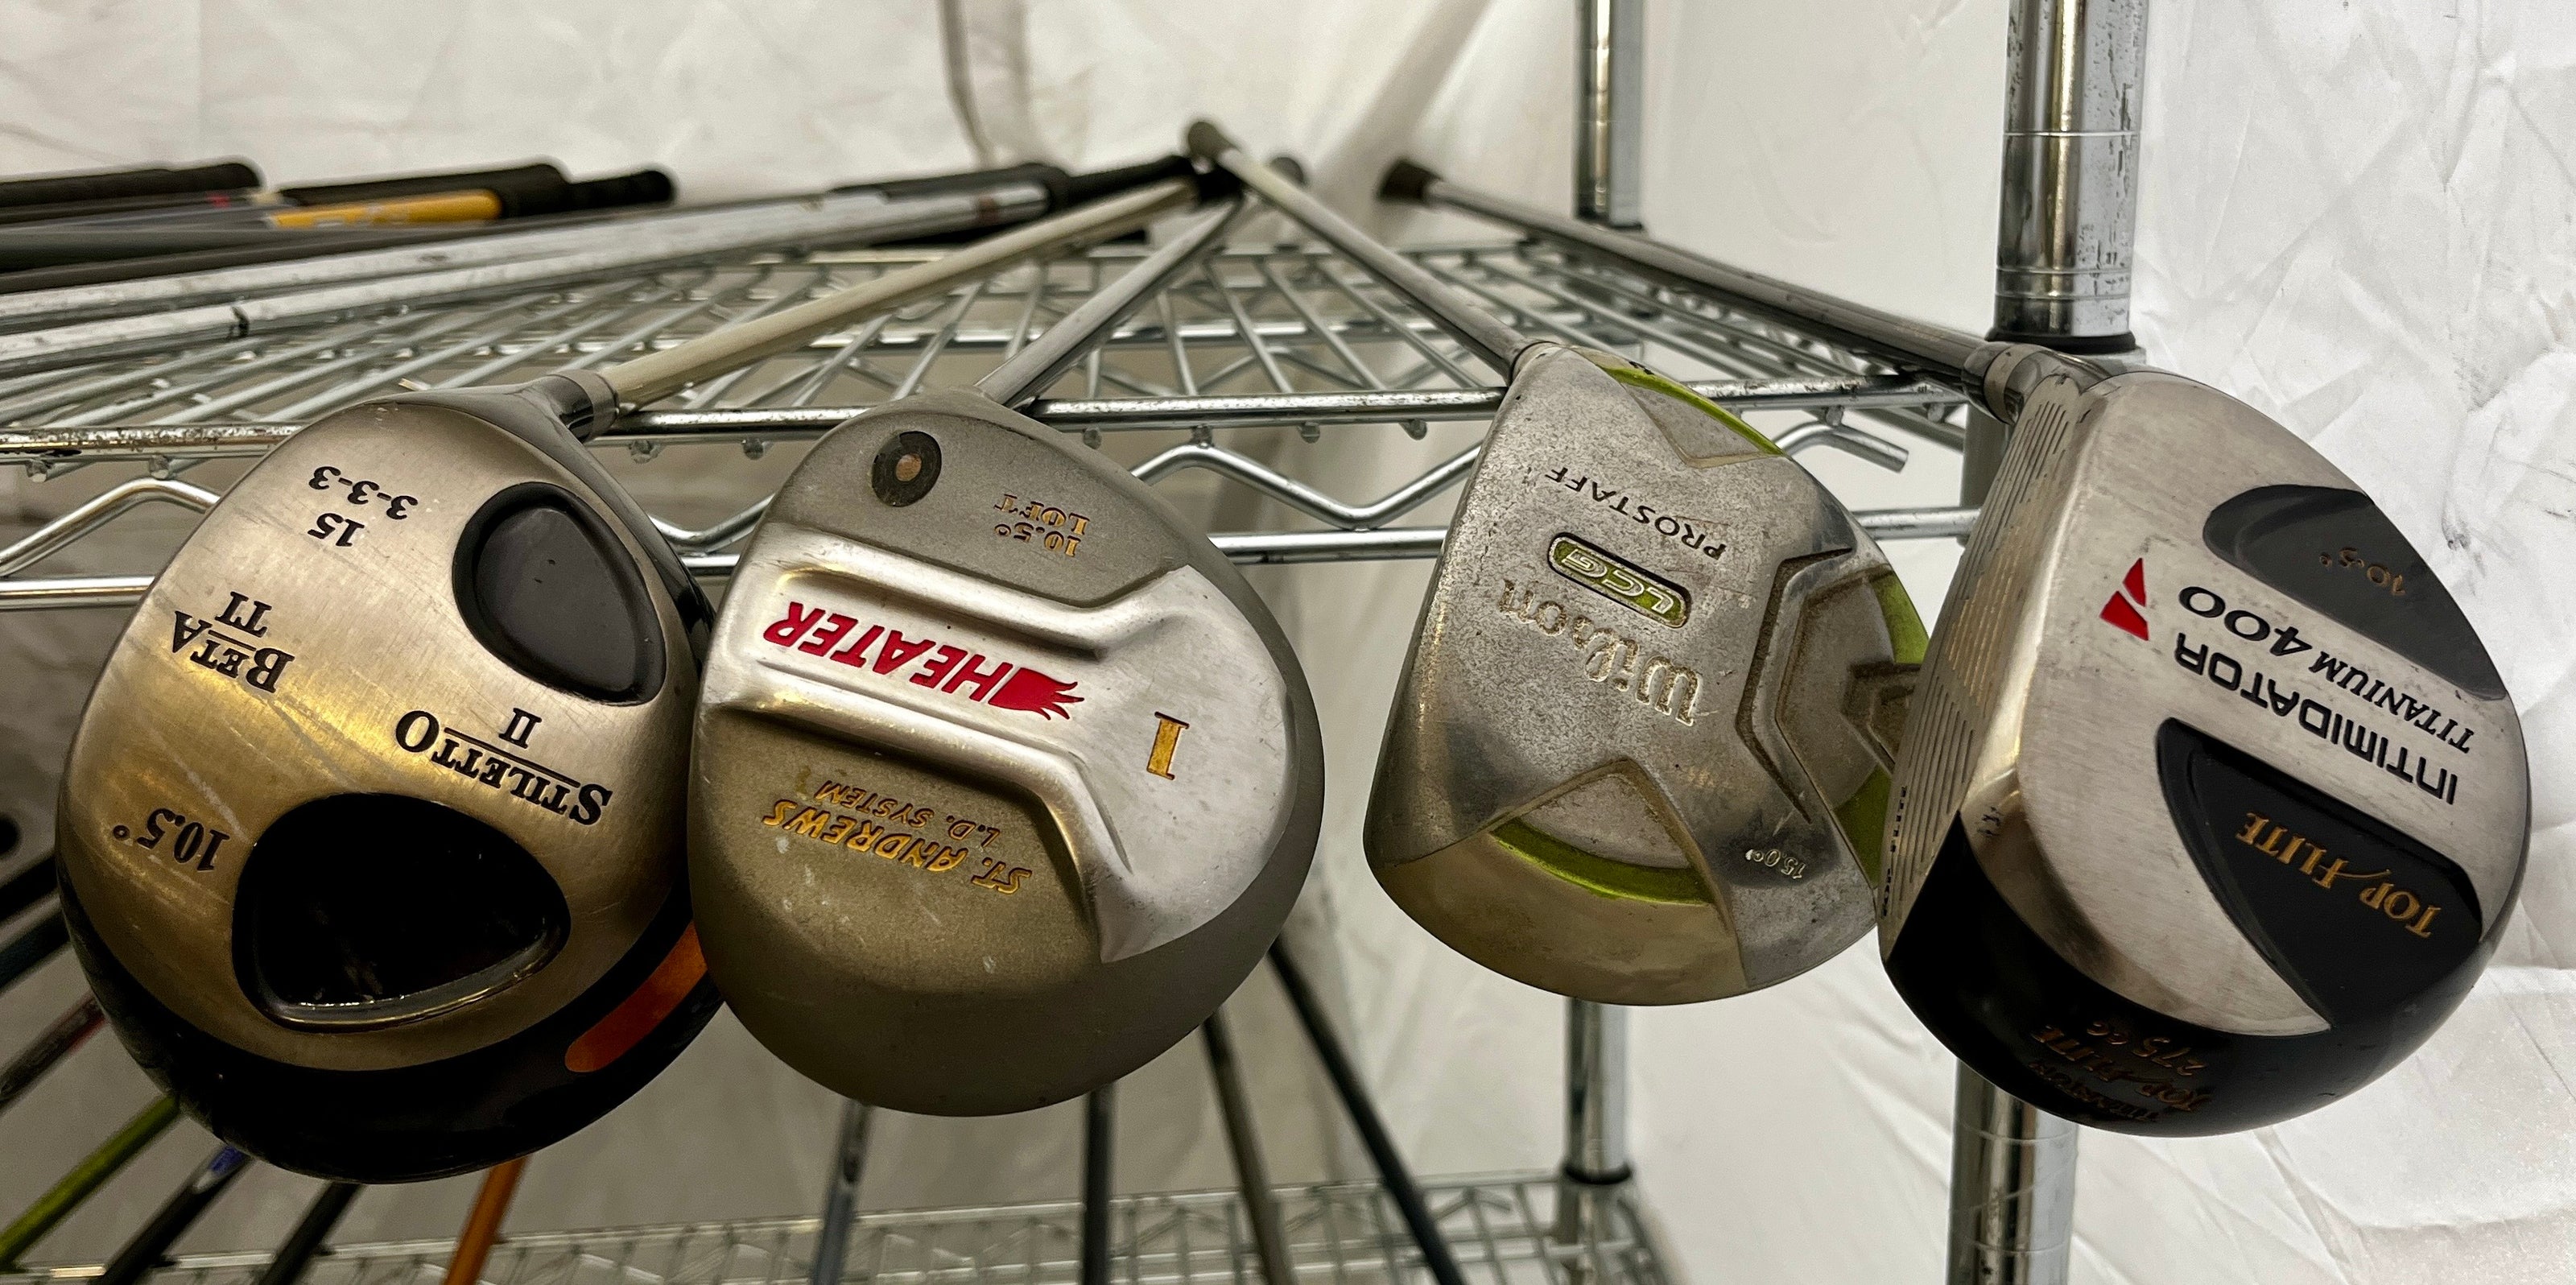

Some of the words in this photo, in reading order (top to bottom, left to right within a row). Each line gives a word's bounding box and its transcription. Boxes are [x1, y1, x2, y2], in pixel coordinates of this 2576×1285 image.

[307, 465, 419, 521] 3-3-3
[993, 494, 1090, 535] LOFT
[1545, 465, 1728, 560] PROSTAFF
[307, 512, 365, 548] 15
[993, 523, 1080, 558] 10.5°
[214, 590, 272, 639] TI
[1560, 547, 1676, 616] LCG
[170, 610, 295, 693] BETA
[763, 601, 1013, 703] HEATER
[1496, 578, 1703, 726] Wilson
[2178, 586, 2310, 658] 400
[498, 706, 543, 750] II
[2174, 631, 2458, 805] INTIMIDATOR
[2311, 651, 2474, 754] TITANIUM
[395, 709, 613, 825] STILETTO
[1146, 711, 1190, 781] 1
[760, 799, 967, 873] ANDREWS
[814, 780, 934, 829] SYSTEM
[946, 813, 1001, 848] L.D.
[111, 807, 231, 873] 10.5°
[2235, 810, 2351, 894] FLITE
[969, 857, 1032, 895] ST.
[2358, 869, 2442, 937] TOP
[2132, 1036, 2207, 1076] 275
